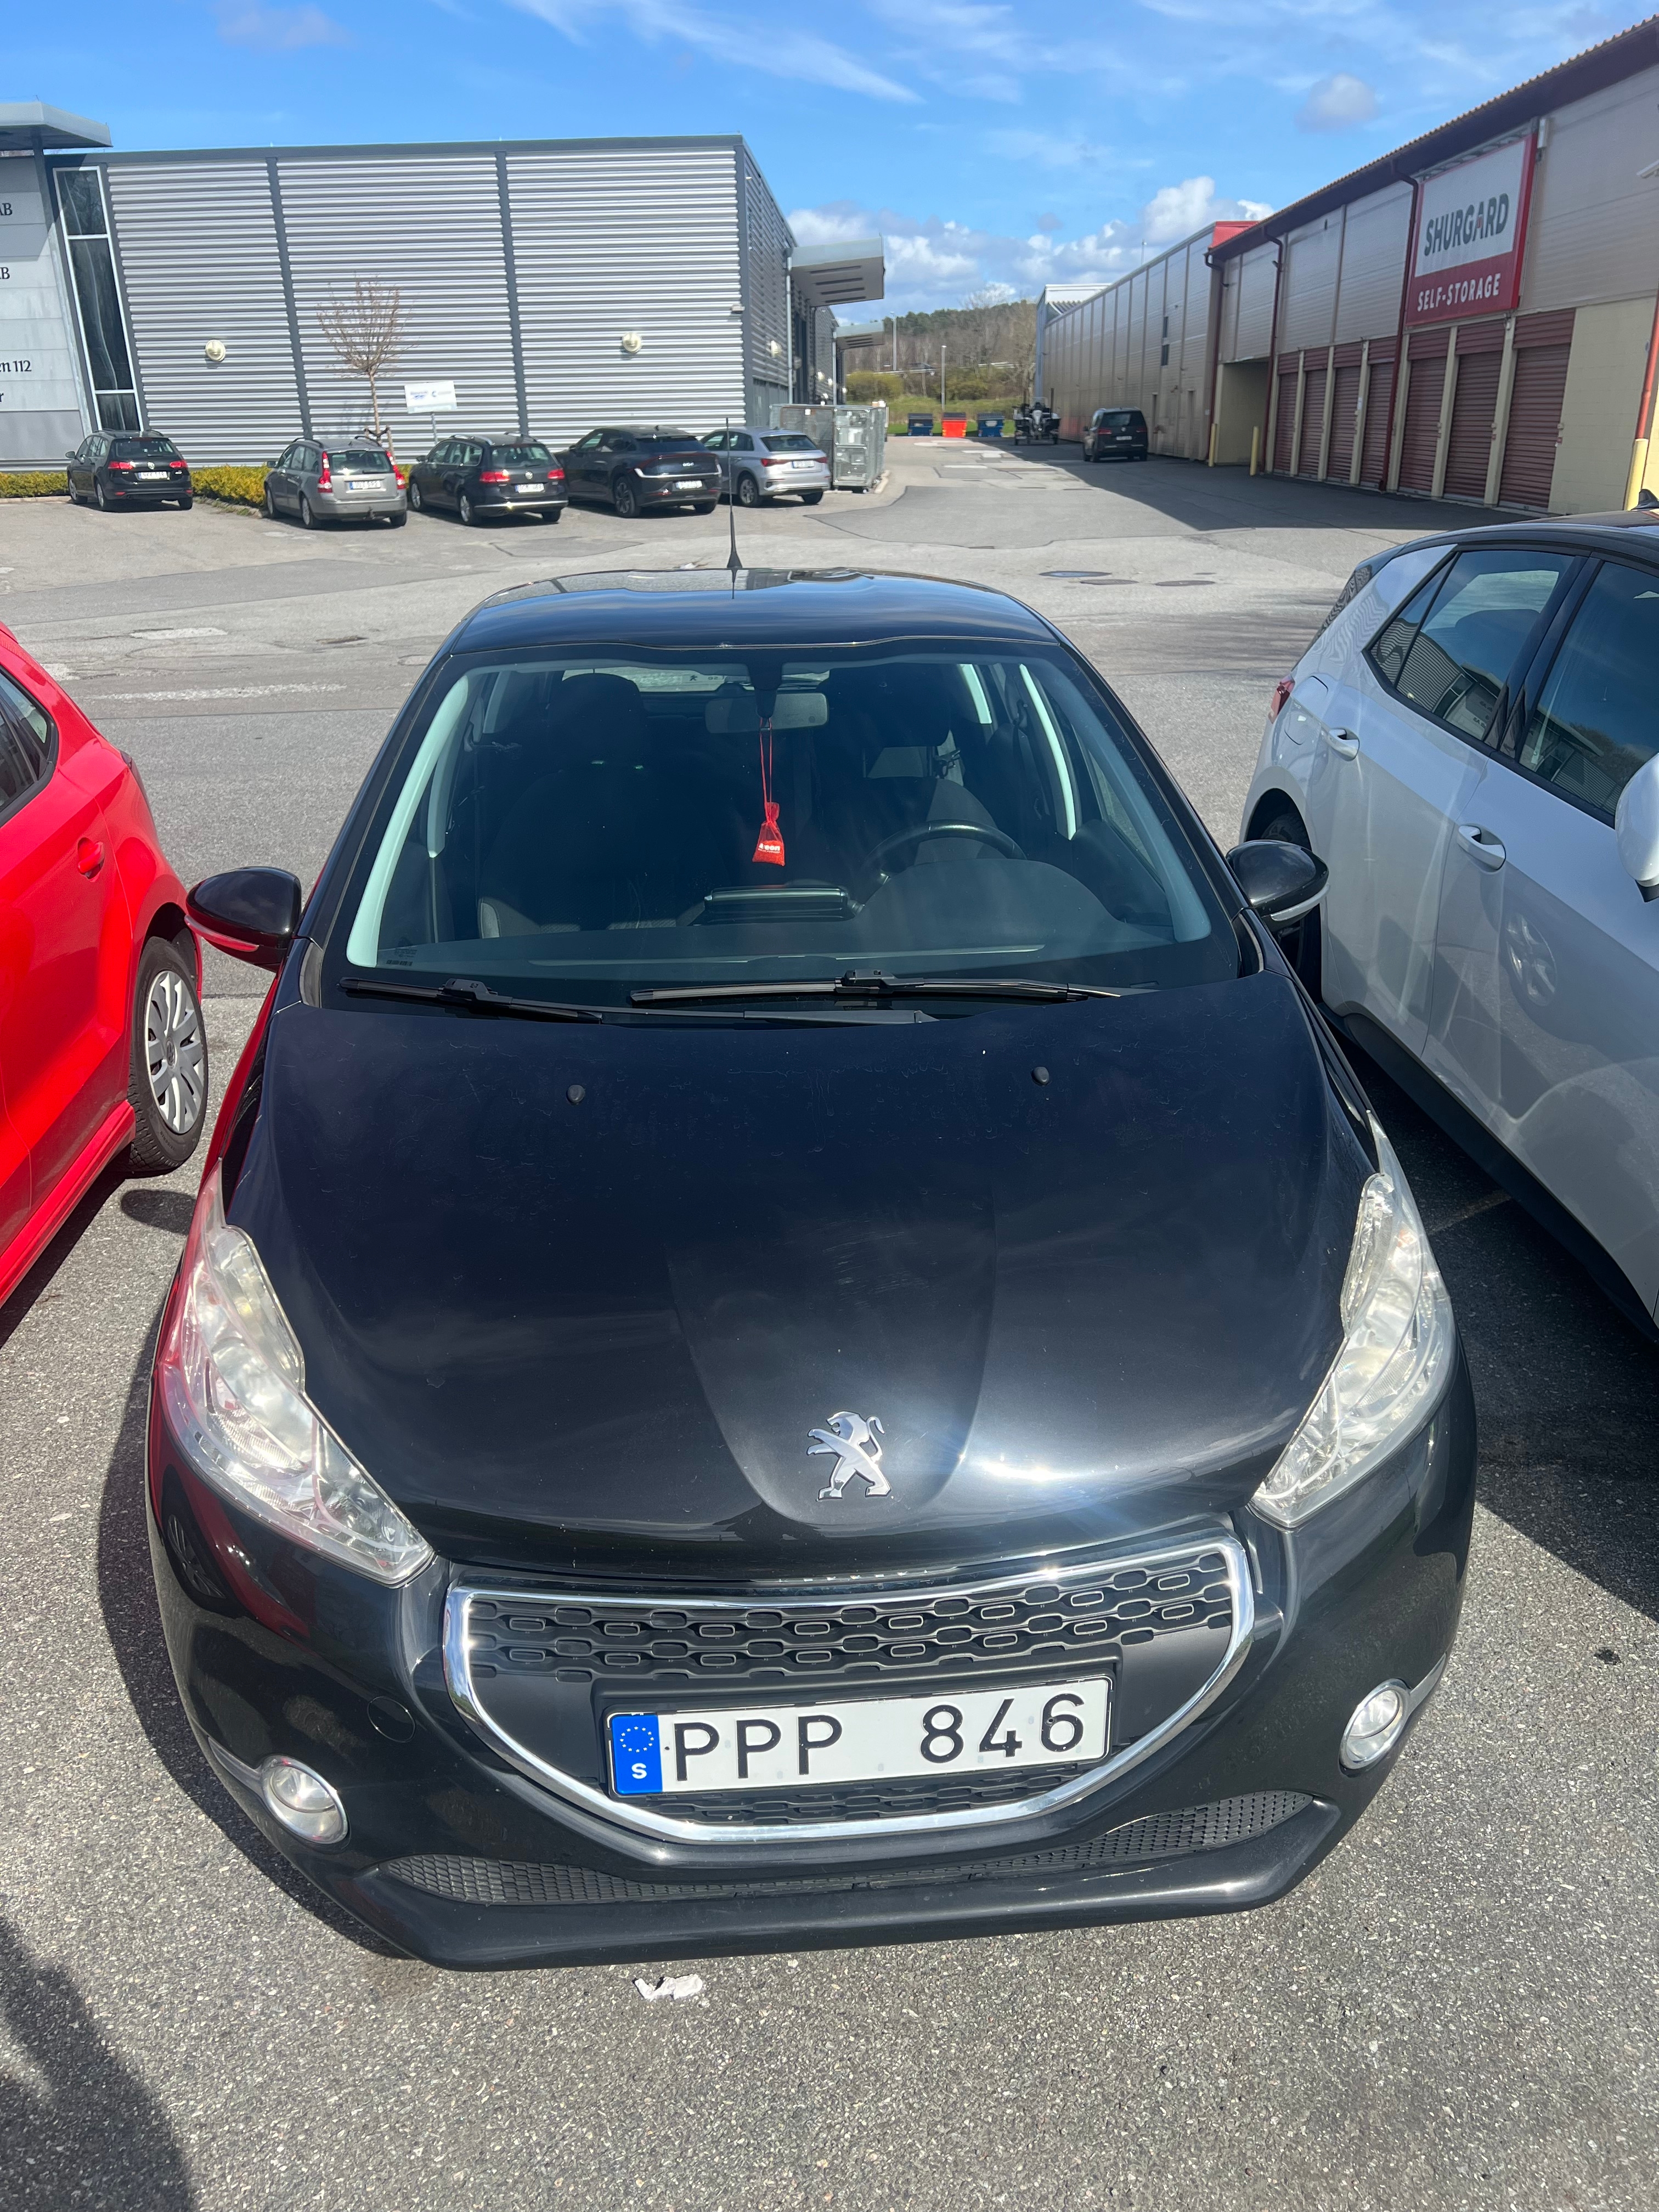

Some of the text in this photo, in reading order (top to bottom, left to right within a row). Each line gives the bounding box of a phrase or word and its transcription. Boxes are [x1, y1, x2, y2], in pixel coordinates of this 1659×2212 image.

[1424, 193, 1509, 256] SHURGARD
[0, 267, 10, 279] B
[1417, 273, 1501, 312] SELF-STORAGE
[13, 360, 32, 372] 112
[674, 1693, 1084, 1781] PPP 846
[631, 1763, 647, 1779] S
